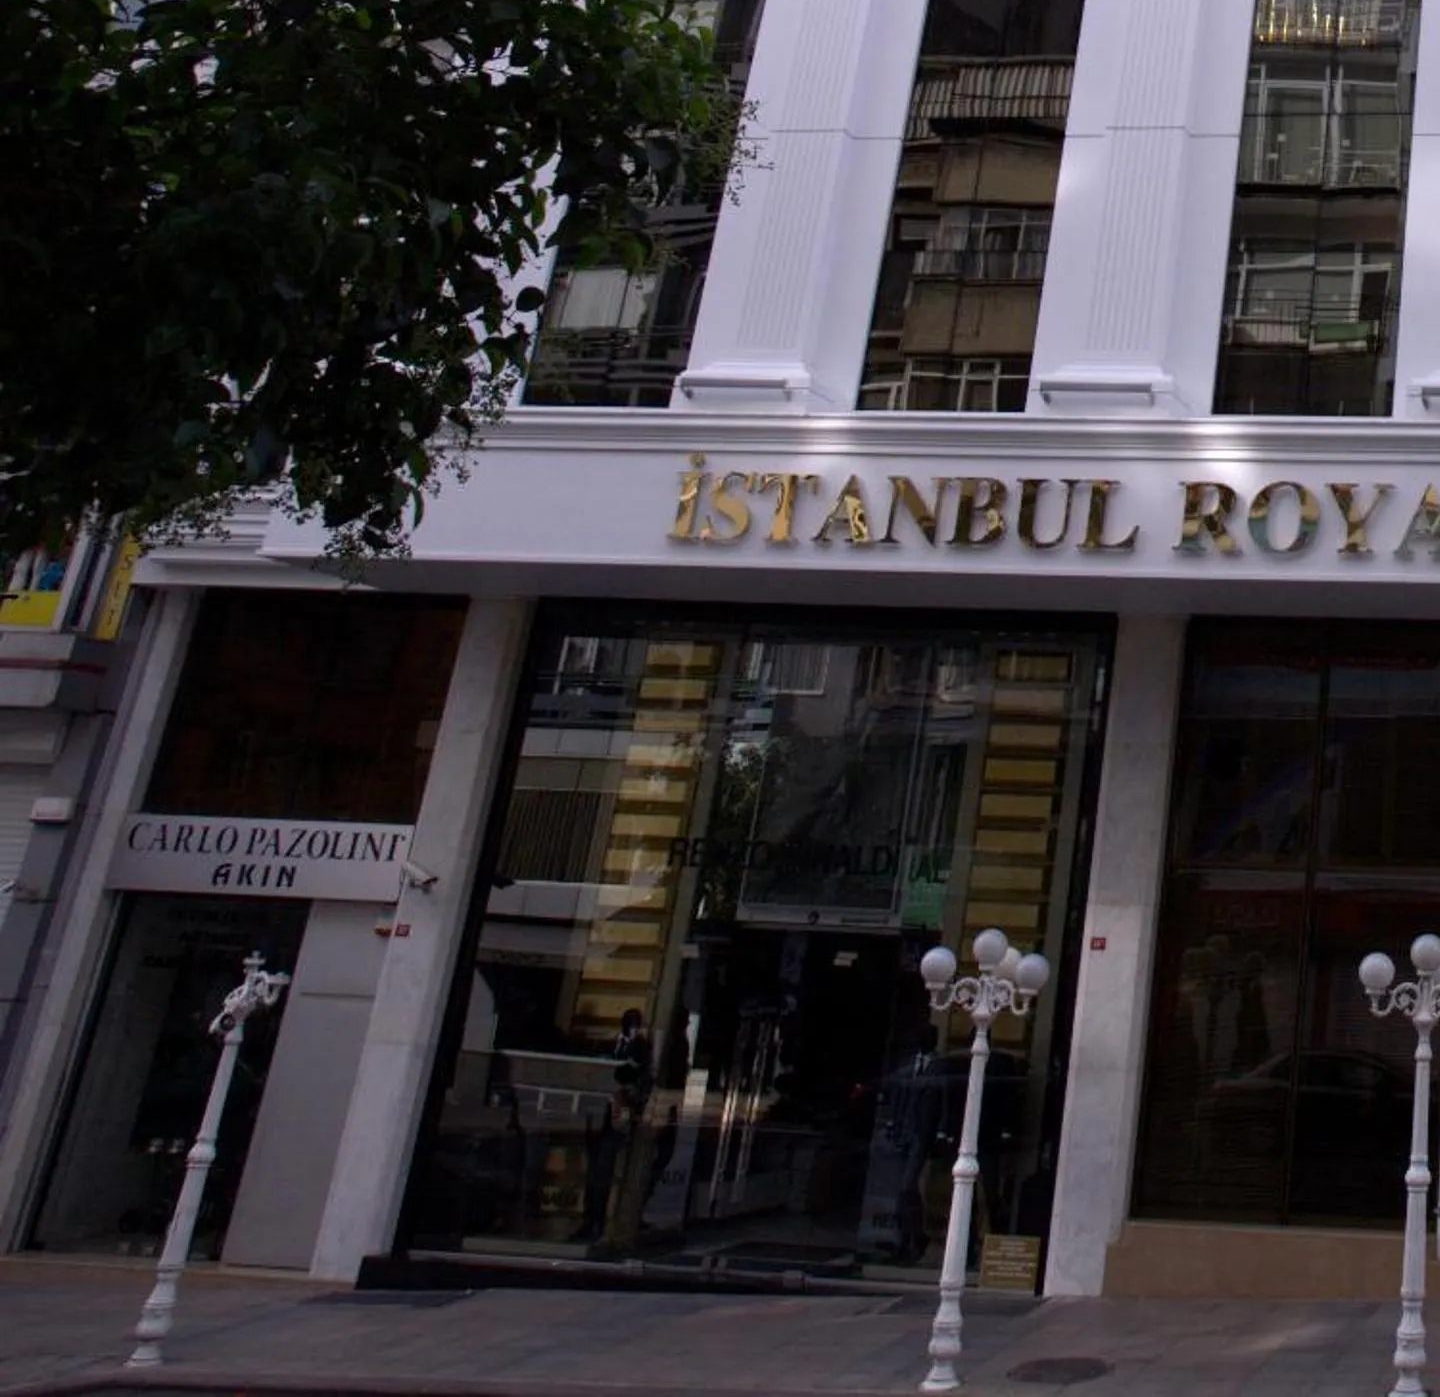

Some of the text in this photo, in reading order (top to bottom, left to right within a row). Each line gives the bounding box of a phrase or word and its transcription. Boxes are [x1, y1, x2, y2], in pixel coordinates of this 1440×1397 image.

[667, 451, 1140, 551] İSTANBUL
[128, 822, 400, 861] CARLO PAZOLINI
[212, 862, 297, 888] AKIN
